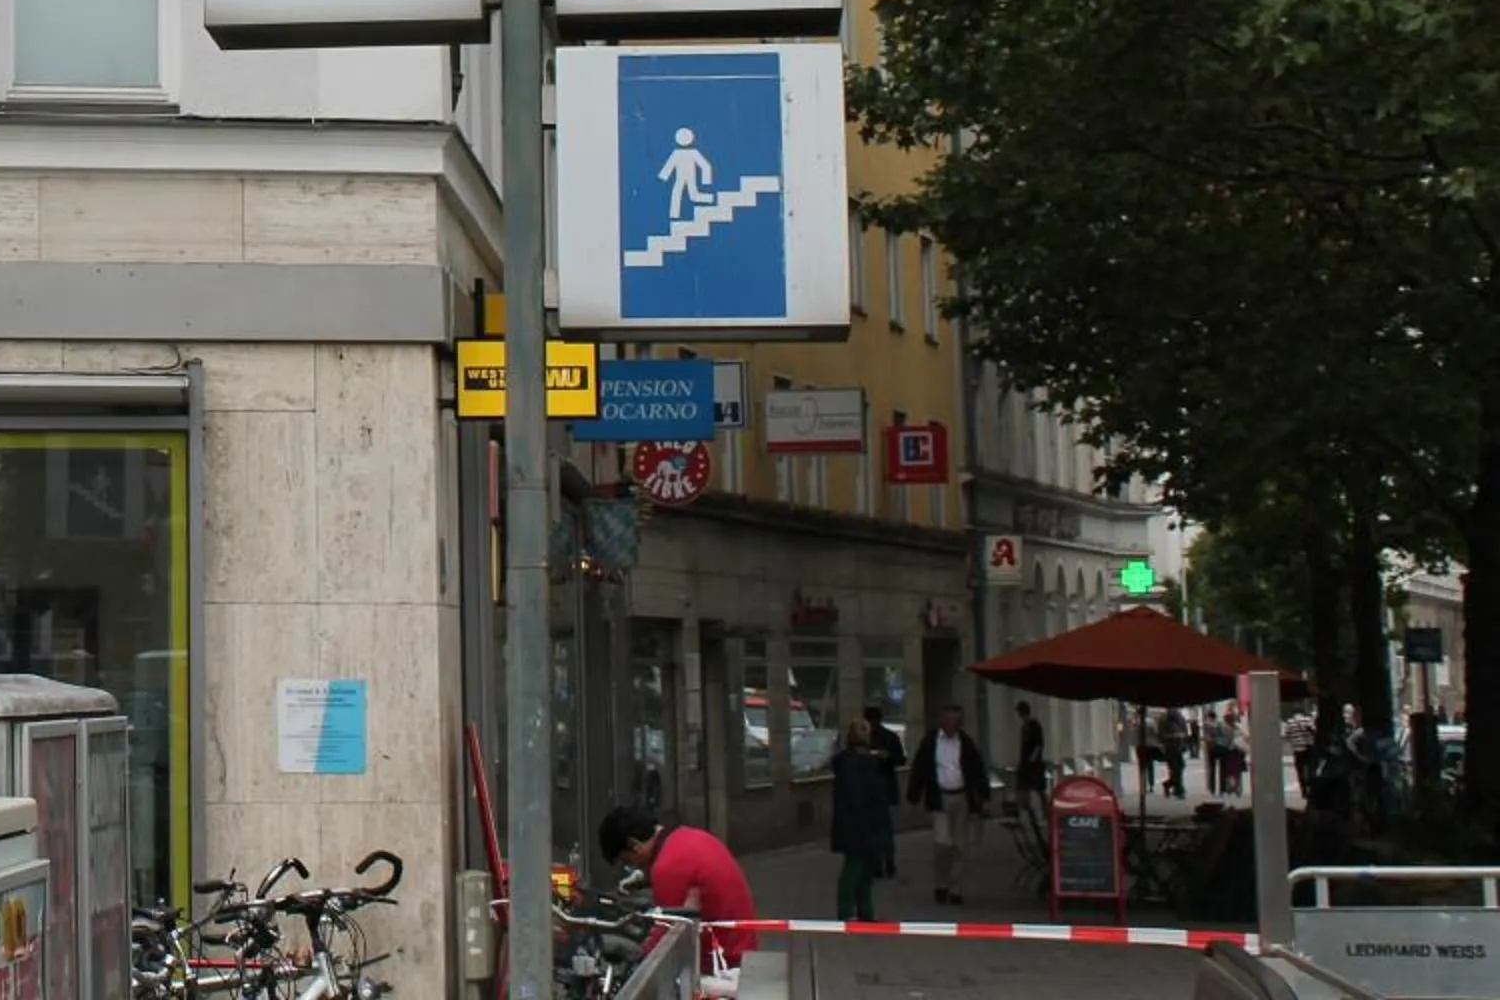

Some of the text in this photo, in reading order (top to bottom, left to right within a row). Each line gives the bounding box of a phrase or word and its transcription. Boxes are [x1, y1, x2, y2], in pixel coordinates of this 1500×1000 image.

[467, 369, 505, 379] WEST
[601, 379, 693, 397] PENSION
[603, 402, 698, 420] OCARNO
